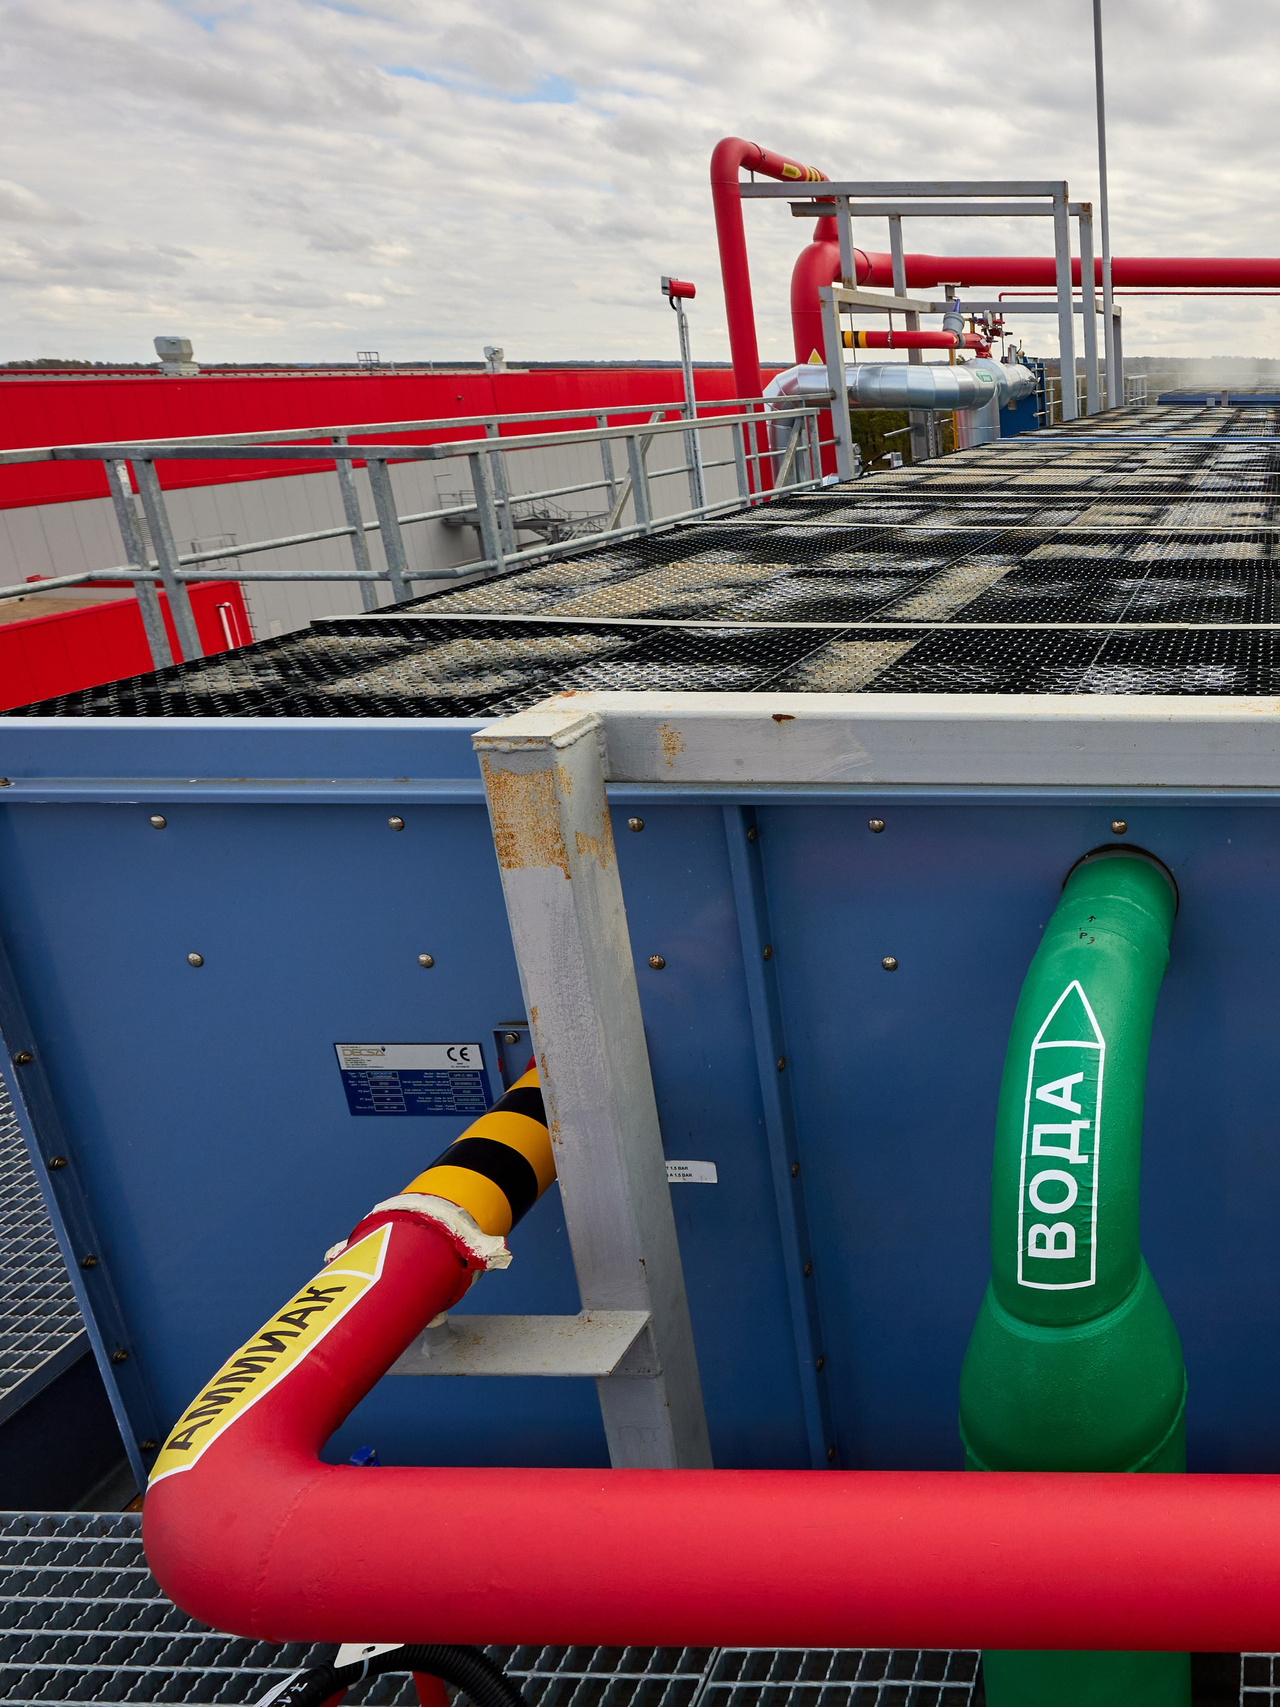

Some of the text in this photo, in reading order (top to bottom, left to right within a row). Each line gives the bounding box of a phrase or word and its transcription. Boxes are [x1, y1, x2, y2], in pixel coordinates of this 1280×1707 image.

[341, 1048, 386, 1057] DECSA
[446, 1047, 471, 1062] CE
[1028, 1072, 1091, 1259] ВОДА
[165, 1286, 347, 1451] АММИАК
